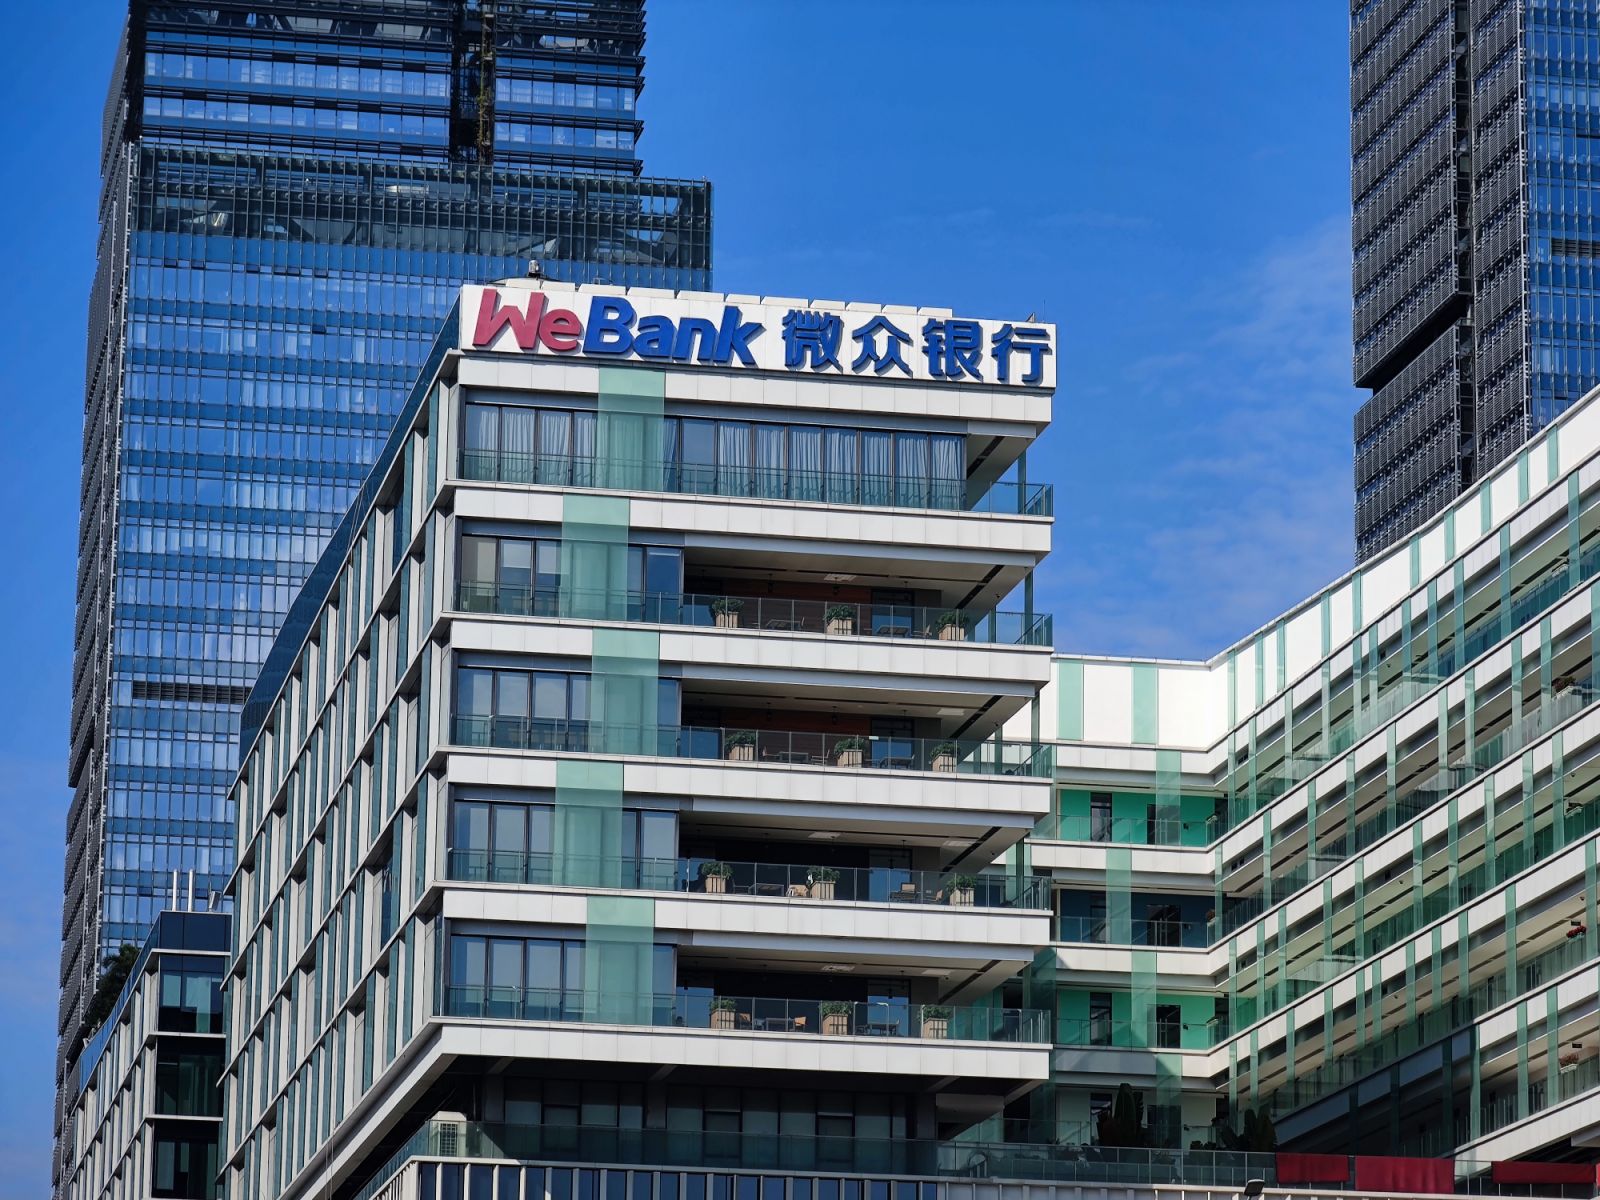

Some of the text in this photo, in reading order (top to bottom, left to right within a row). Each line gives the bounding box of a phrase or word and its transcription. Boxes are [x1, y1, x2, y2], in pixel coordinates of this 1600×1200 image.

[472, 288, 1050, 383] WeBank 微众银行
